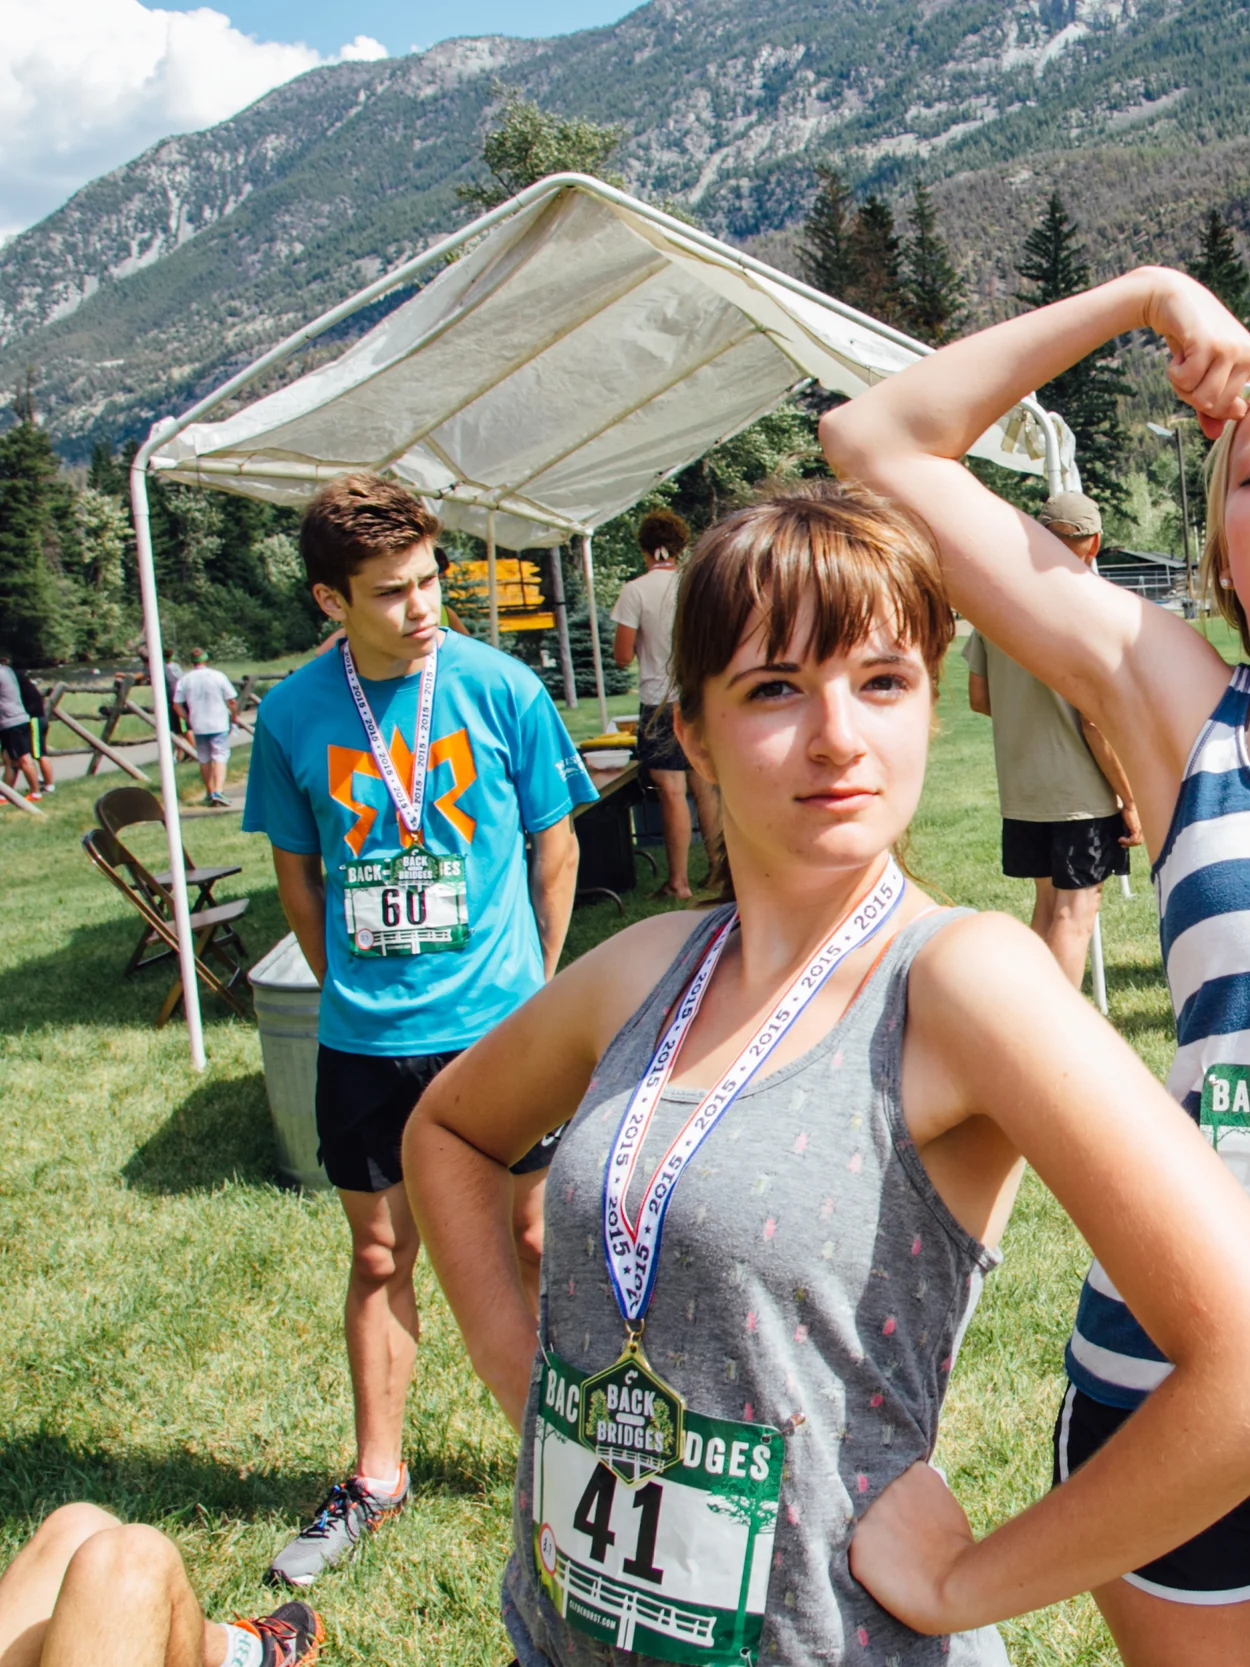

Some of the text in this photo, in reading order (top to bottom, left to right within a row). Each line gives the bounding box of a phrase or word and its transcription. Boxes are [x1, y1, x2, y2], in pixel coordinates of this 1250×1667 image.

[344, 652, 408, 809] 2015 2015 2015 2015 2015
[414, 671, 433, 804] 2015 2015 2015 2015
[348, 864, 382, 883] BACK
[402, 855, 428, 867] BACK
[381, 888, 427, 928] 60
[855, 881, 894, 932] 2015
[801, 944, 843, 989] 2015
[749, 1007, 790, 1057] 2015
[608, 972, 707, 1257] 2015 2015 2015 2015
[694, 1079, 737, 1132] 2015
[648, 1154, 683, 1215] 2015
[546, 1368, 771, 1482] BAC DGES
[606, 1383, 656, 1418] BACK
[596, 1419, 664, 1453] BRIDGES
[573, 1461, 664, 1586] 41
[568, 1599, 617, 1630] CLYDEHURST.COM
